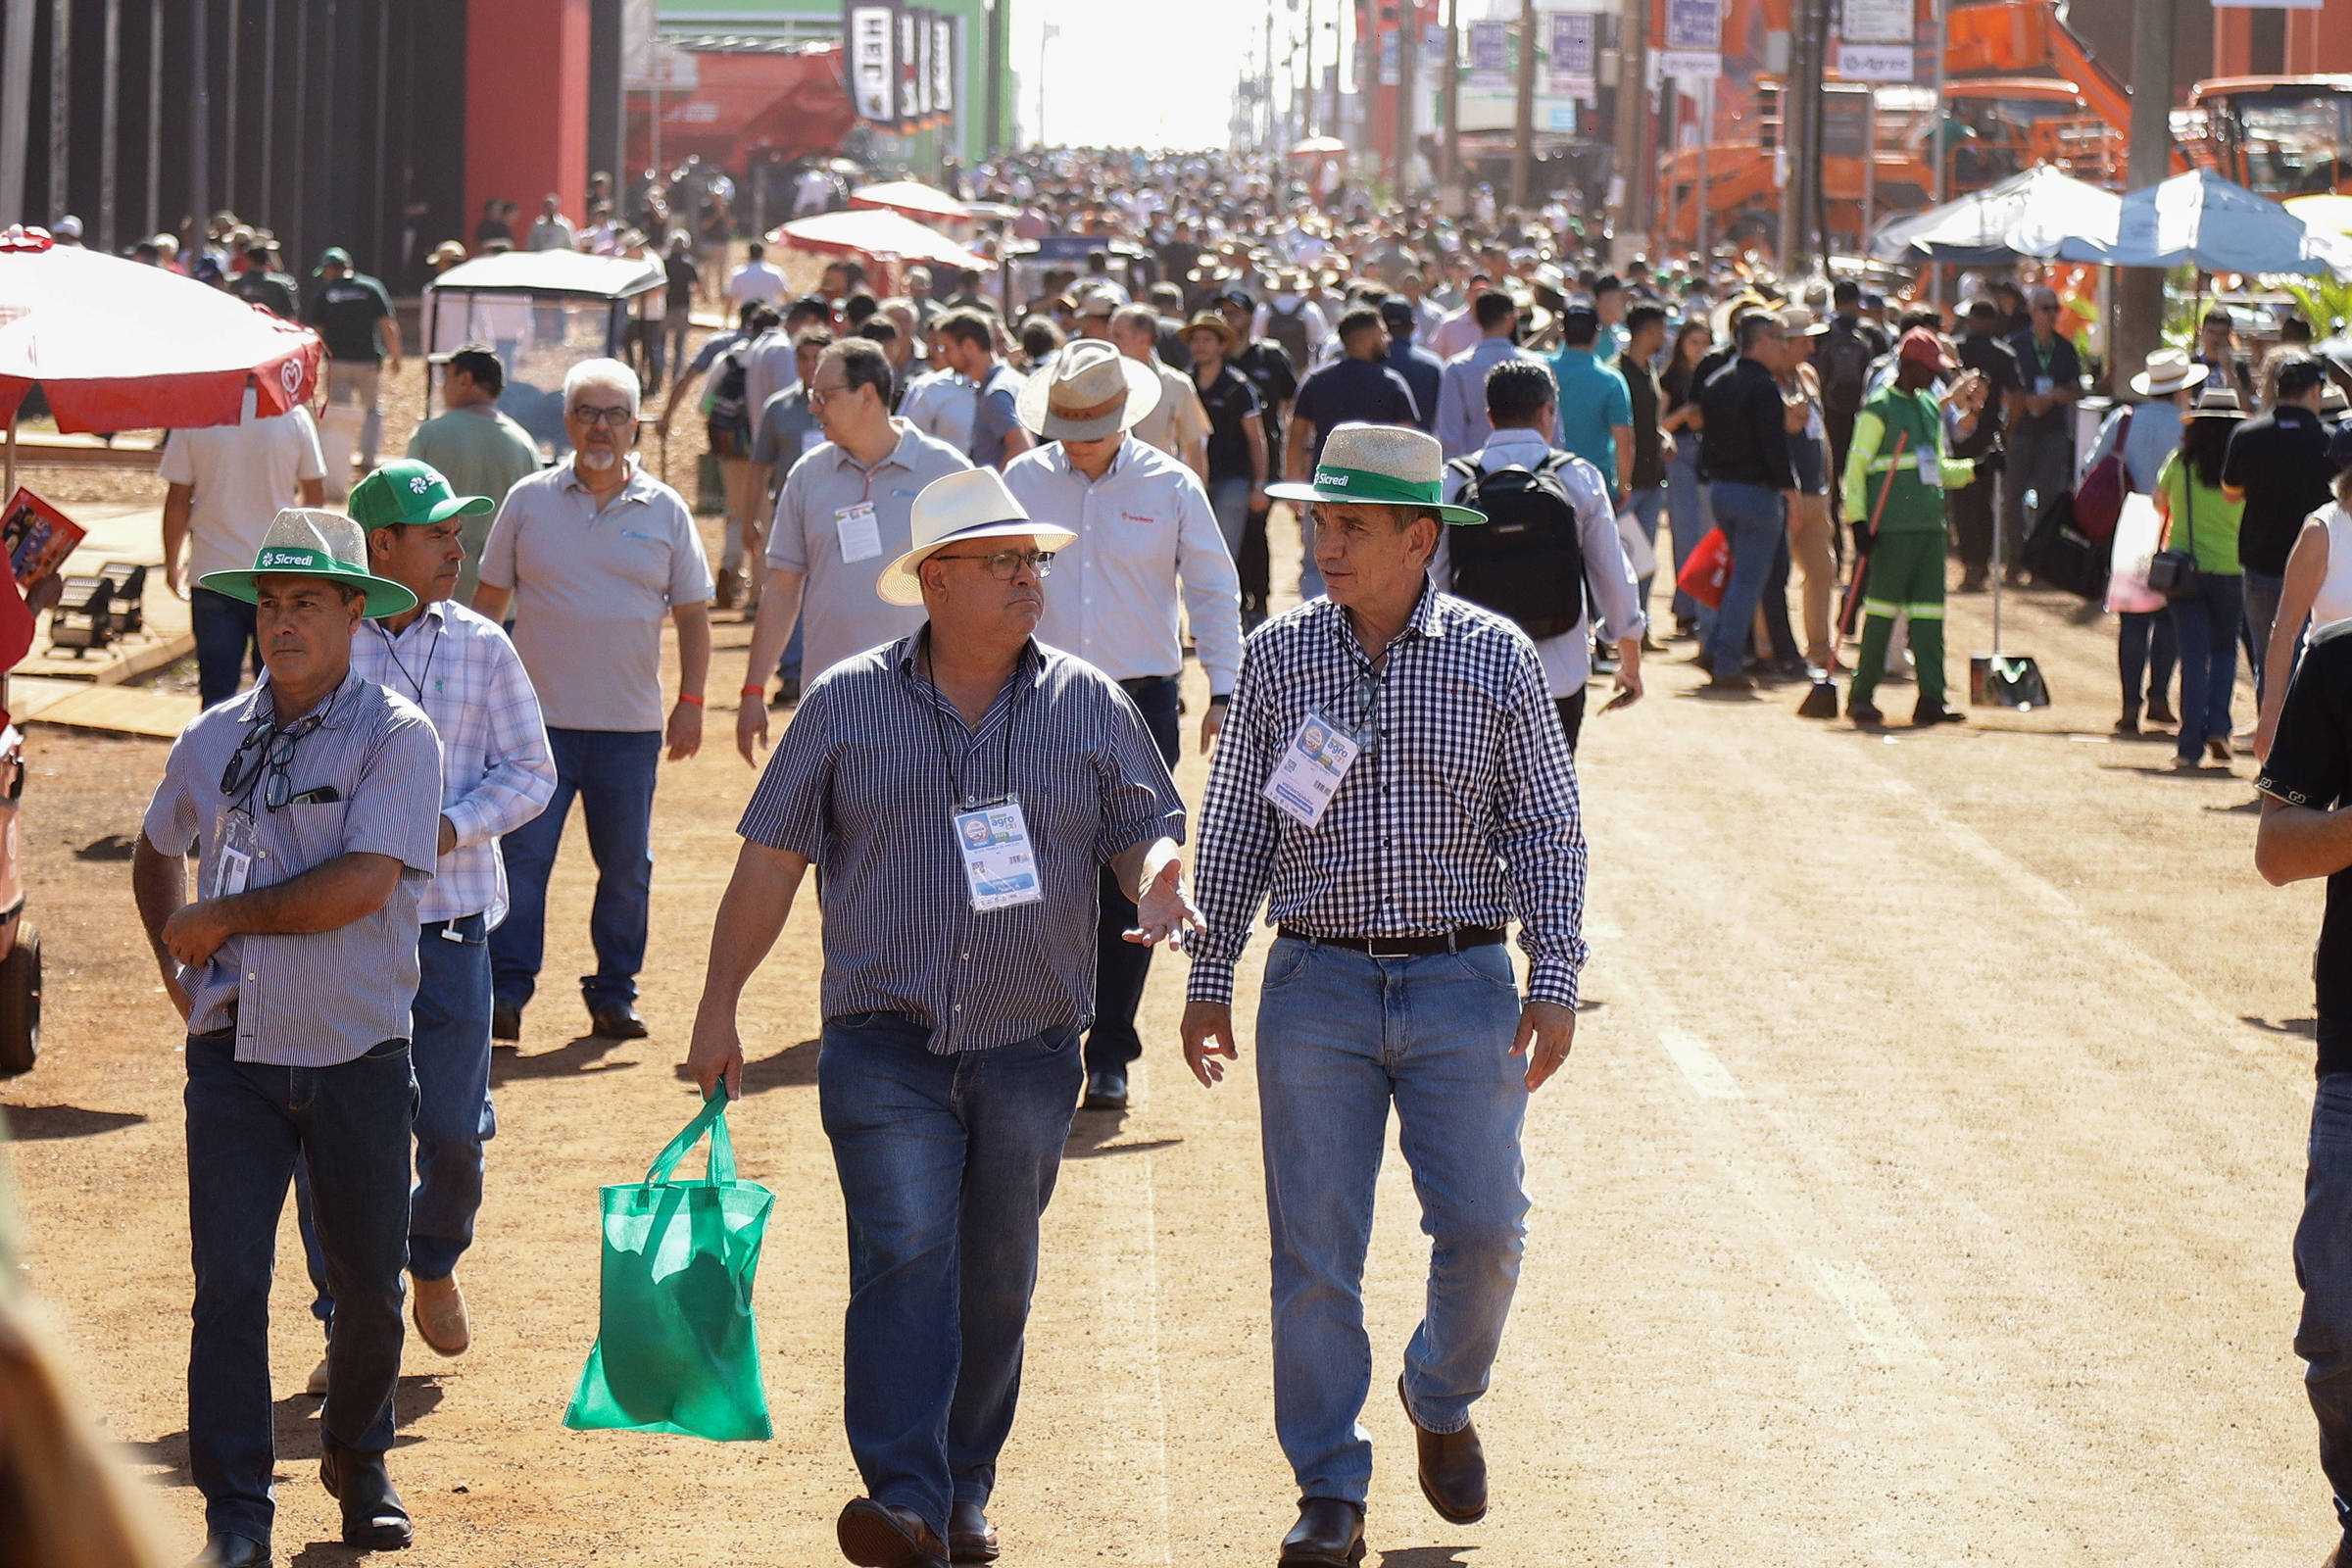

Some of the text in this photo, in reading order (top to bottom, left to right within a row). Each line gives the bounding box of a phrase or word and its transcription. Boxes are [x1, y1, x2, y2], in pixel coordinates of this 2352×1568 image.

[1318, 472, 1349, 486] Sicredi
[273, 553, 313, 566] Sicredi
[992, 815, 1014, 827] agro
